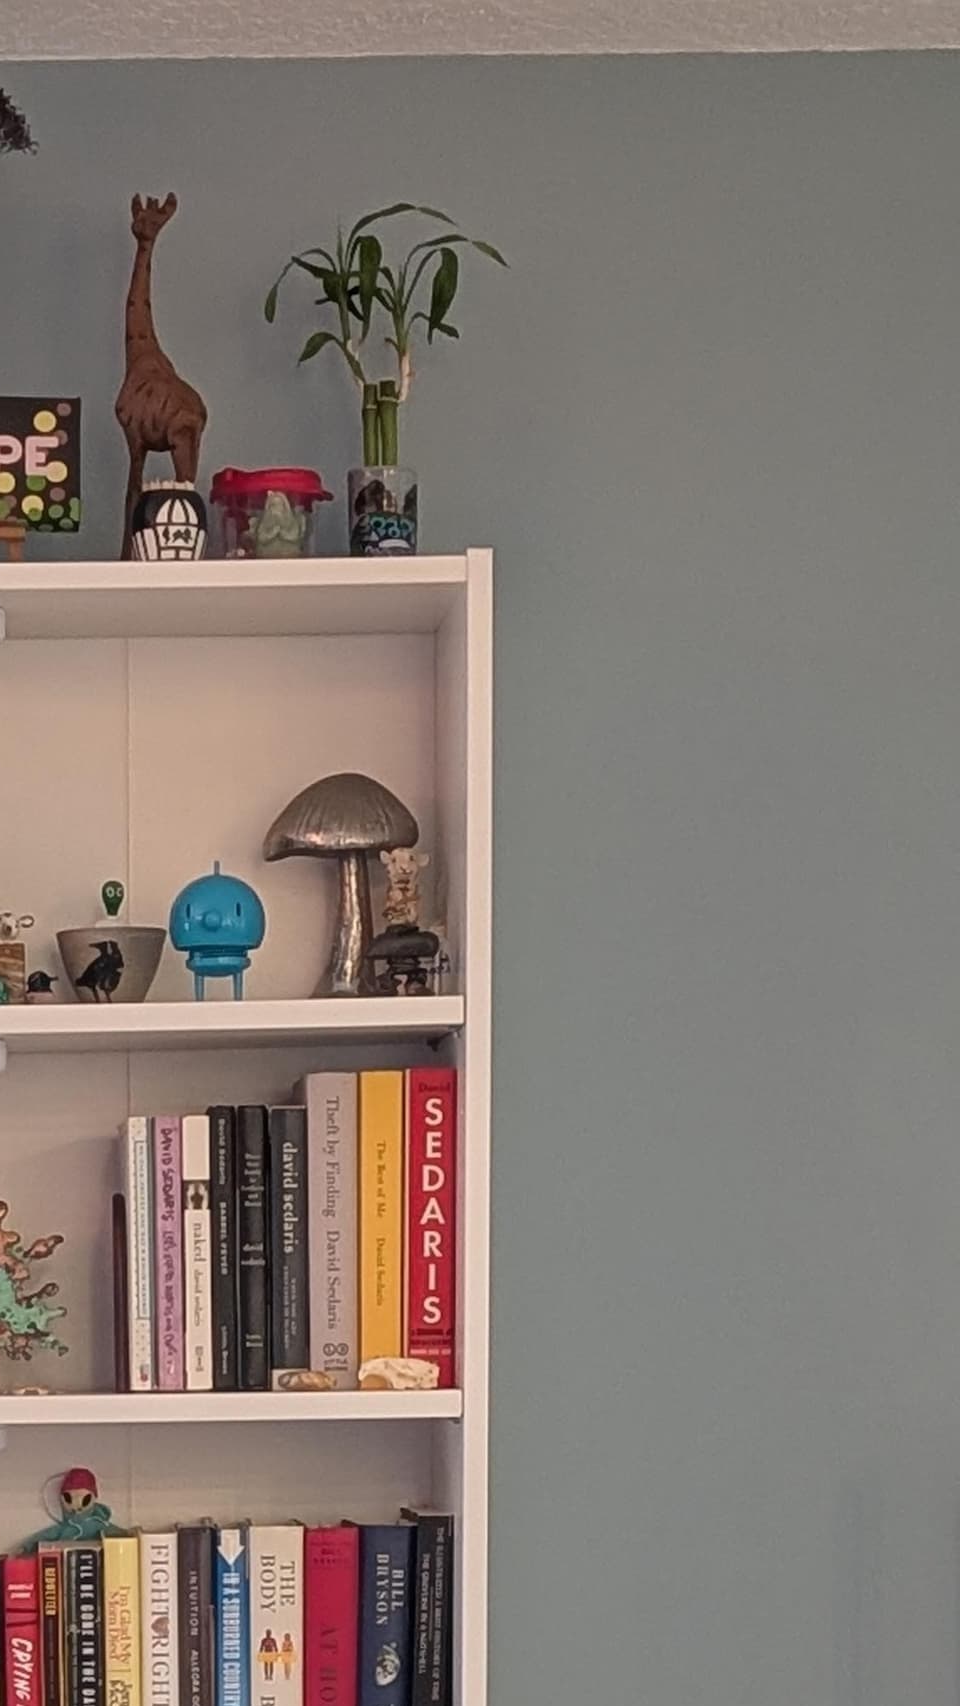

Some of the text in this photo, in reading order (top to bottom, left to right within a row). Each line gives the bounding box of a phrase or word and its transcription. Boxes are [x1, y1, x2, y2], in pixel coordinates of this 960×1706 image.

[160, 1127, 176, 1166] DAVID
[282, 1141, 299, 1189] david
[376, 1140, 386, 1161] The
[376, 1163, 386, 1185] Best
[376, 1187, 386, 1198] of
[161, 1167, 176, 1222] SEDARIS
[321, 1096, 342, 1330] Theft by Finding David Sedaris
[376, 1202, 386, 1218] Me
[419, 1098, 445, 1325] SEDARIS
[192, 1222, 207, 1262] naked
[282, 1193, 299, 1254] sedaris
[375, 1238, 386, 1267] David
[81, 1583, 95, 1600] BE
[150, 1543, 169, 1620] FIGHT
[259, 1554, 277, 1614] BODY
[279, 1561, 295, 1607] THE
[375, 1553, 390, 1626] BRYSON
[391, 1568, 405, 1612] BILL
[81, 1603, 95, 1637] GONE
[107, 1591, 120, 1661] Mom Died
[119, 1609, 131, 1639] Glad
[320, 1624, 337, 1653] AT
[81, 1641, 95, 1655] IN
[117, 1642, 131, 1665] My
[11, 1637, 33, 1700] CRYING
[81, 1660, 95, 1681] THE
[222, 1662, 240, 1706] COUNTRY
